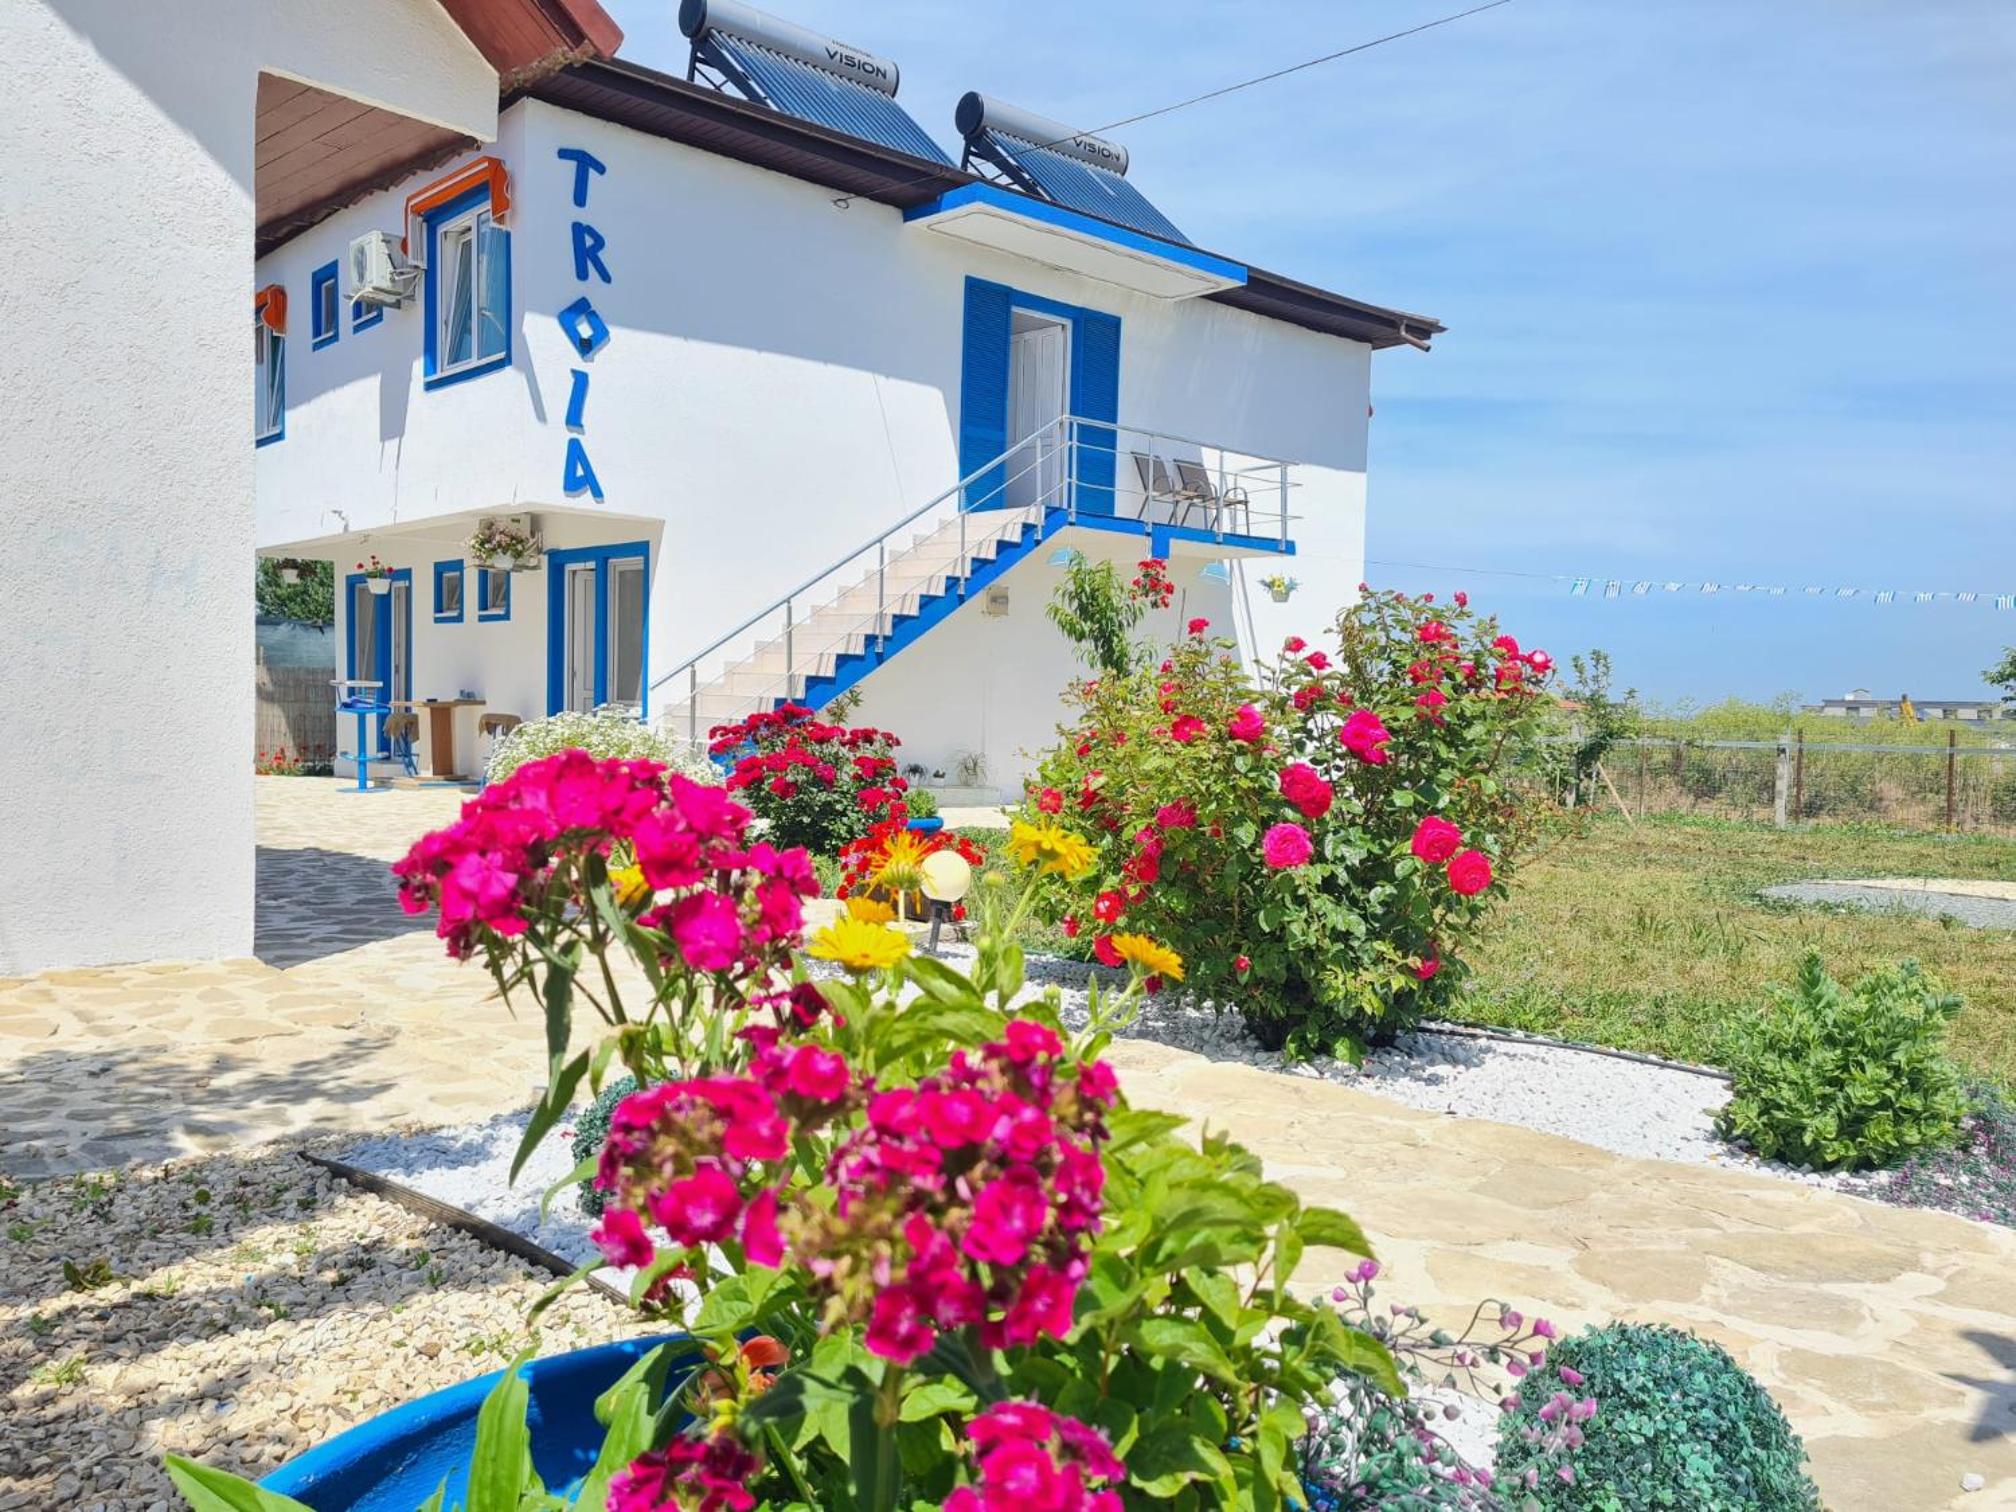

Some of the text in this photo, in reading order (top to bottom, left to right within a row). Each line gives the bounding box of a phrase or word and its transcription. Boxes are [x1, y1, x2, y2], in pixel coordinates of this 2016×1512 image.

[825, 46, 887, 80] VISION
[1073, 137, 1121, 162] VISION
[557, 148, 611, 502] TROIA
